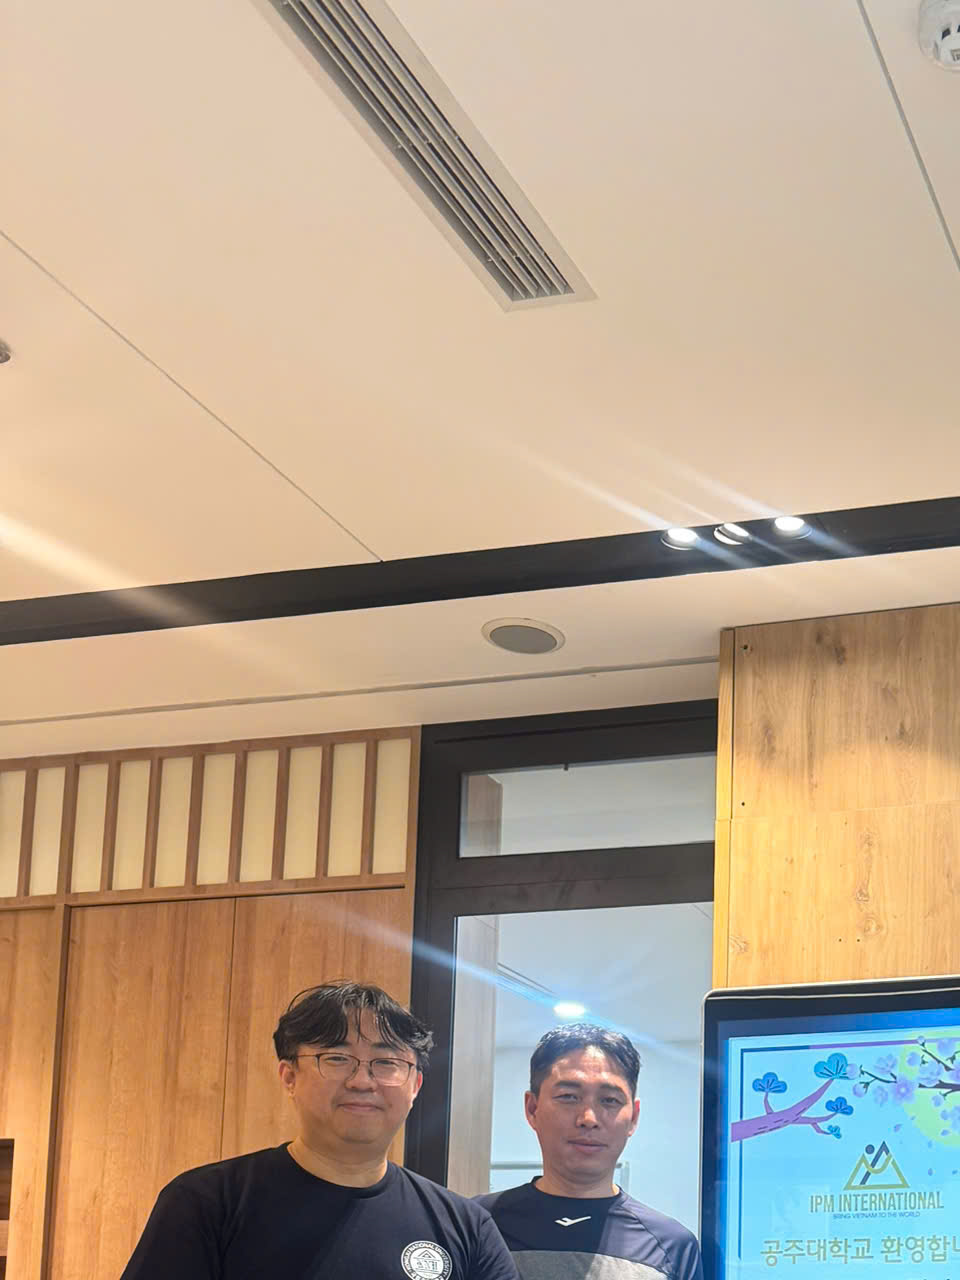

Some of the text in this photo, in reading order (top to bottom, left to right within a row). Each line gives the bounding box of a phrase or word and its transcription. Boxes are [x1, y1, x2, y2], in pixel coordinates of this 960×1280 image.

[809, 1191, 944, 1213] IPM INTERNATIONAL
[410, 1242, 435, 1251] NATIONAL
[760, 1237, 874, 1267] 공주대학교
